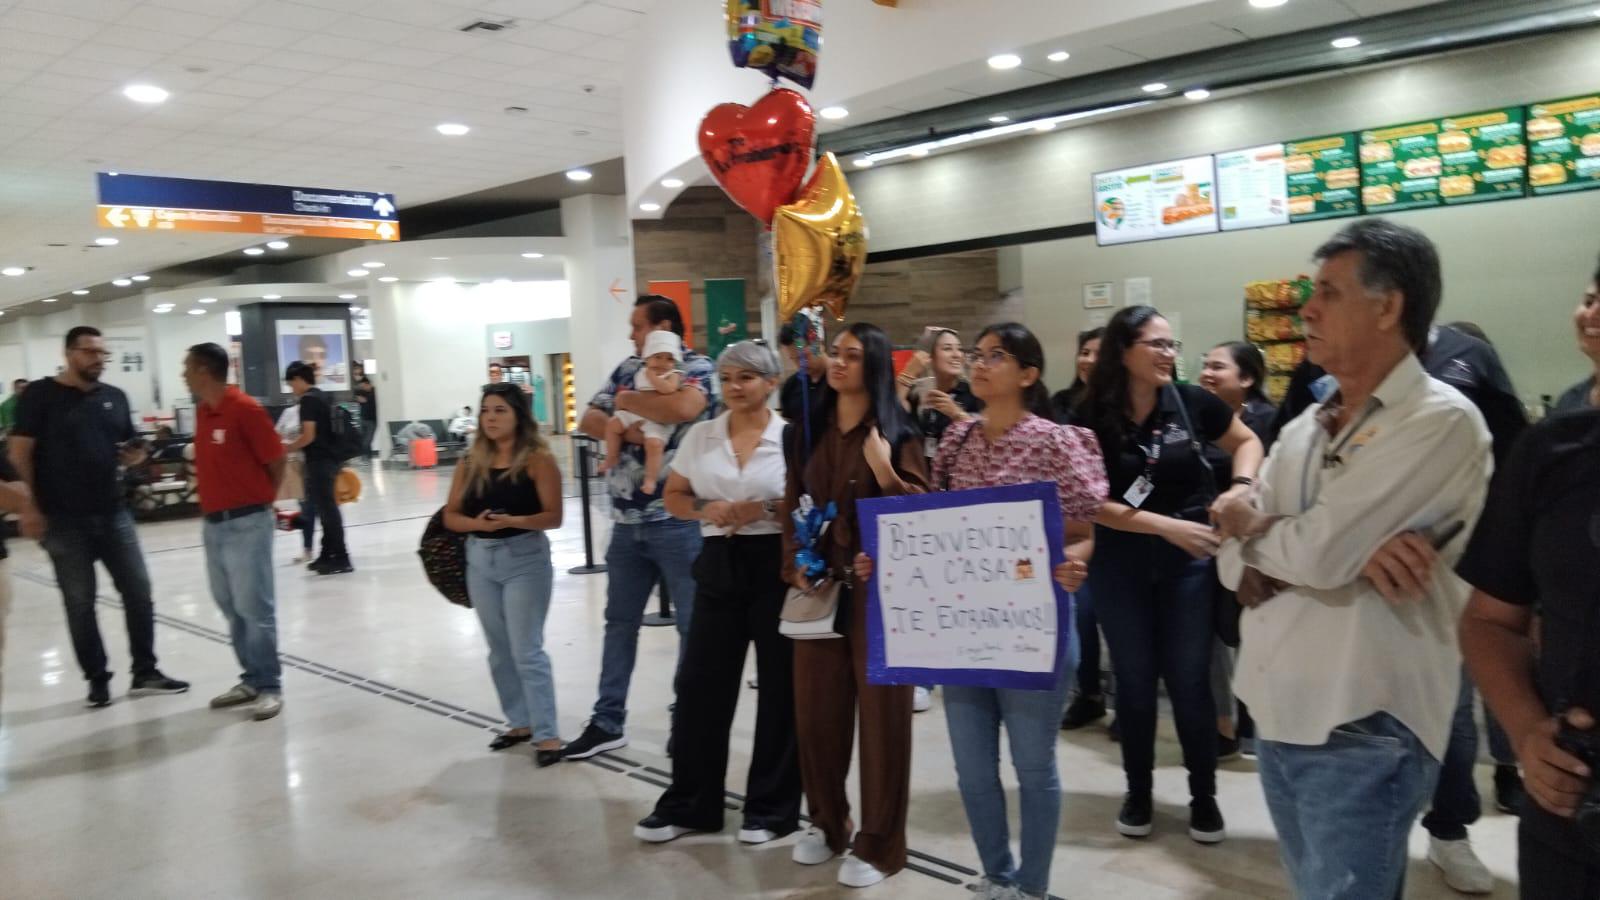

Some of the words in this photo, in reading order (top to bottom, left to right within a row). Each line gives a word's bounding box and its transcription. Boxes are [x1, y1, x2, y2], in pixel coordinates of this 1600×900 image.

[887, 522, 1032, 561] BIENVENIDO
[907, 566, 929, 588] A
[944, 558, 1011, 584] CASA
[890, 606, 926, 633] TE
